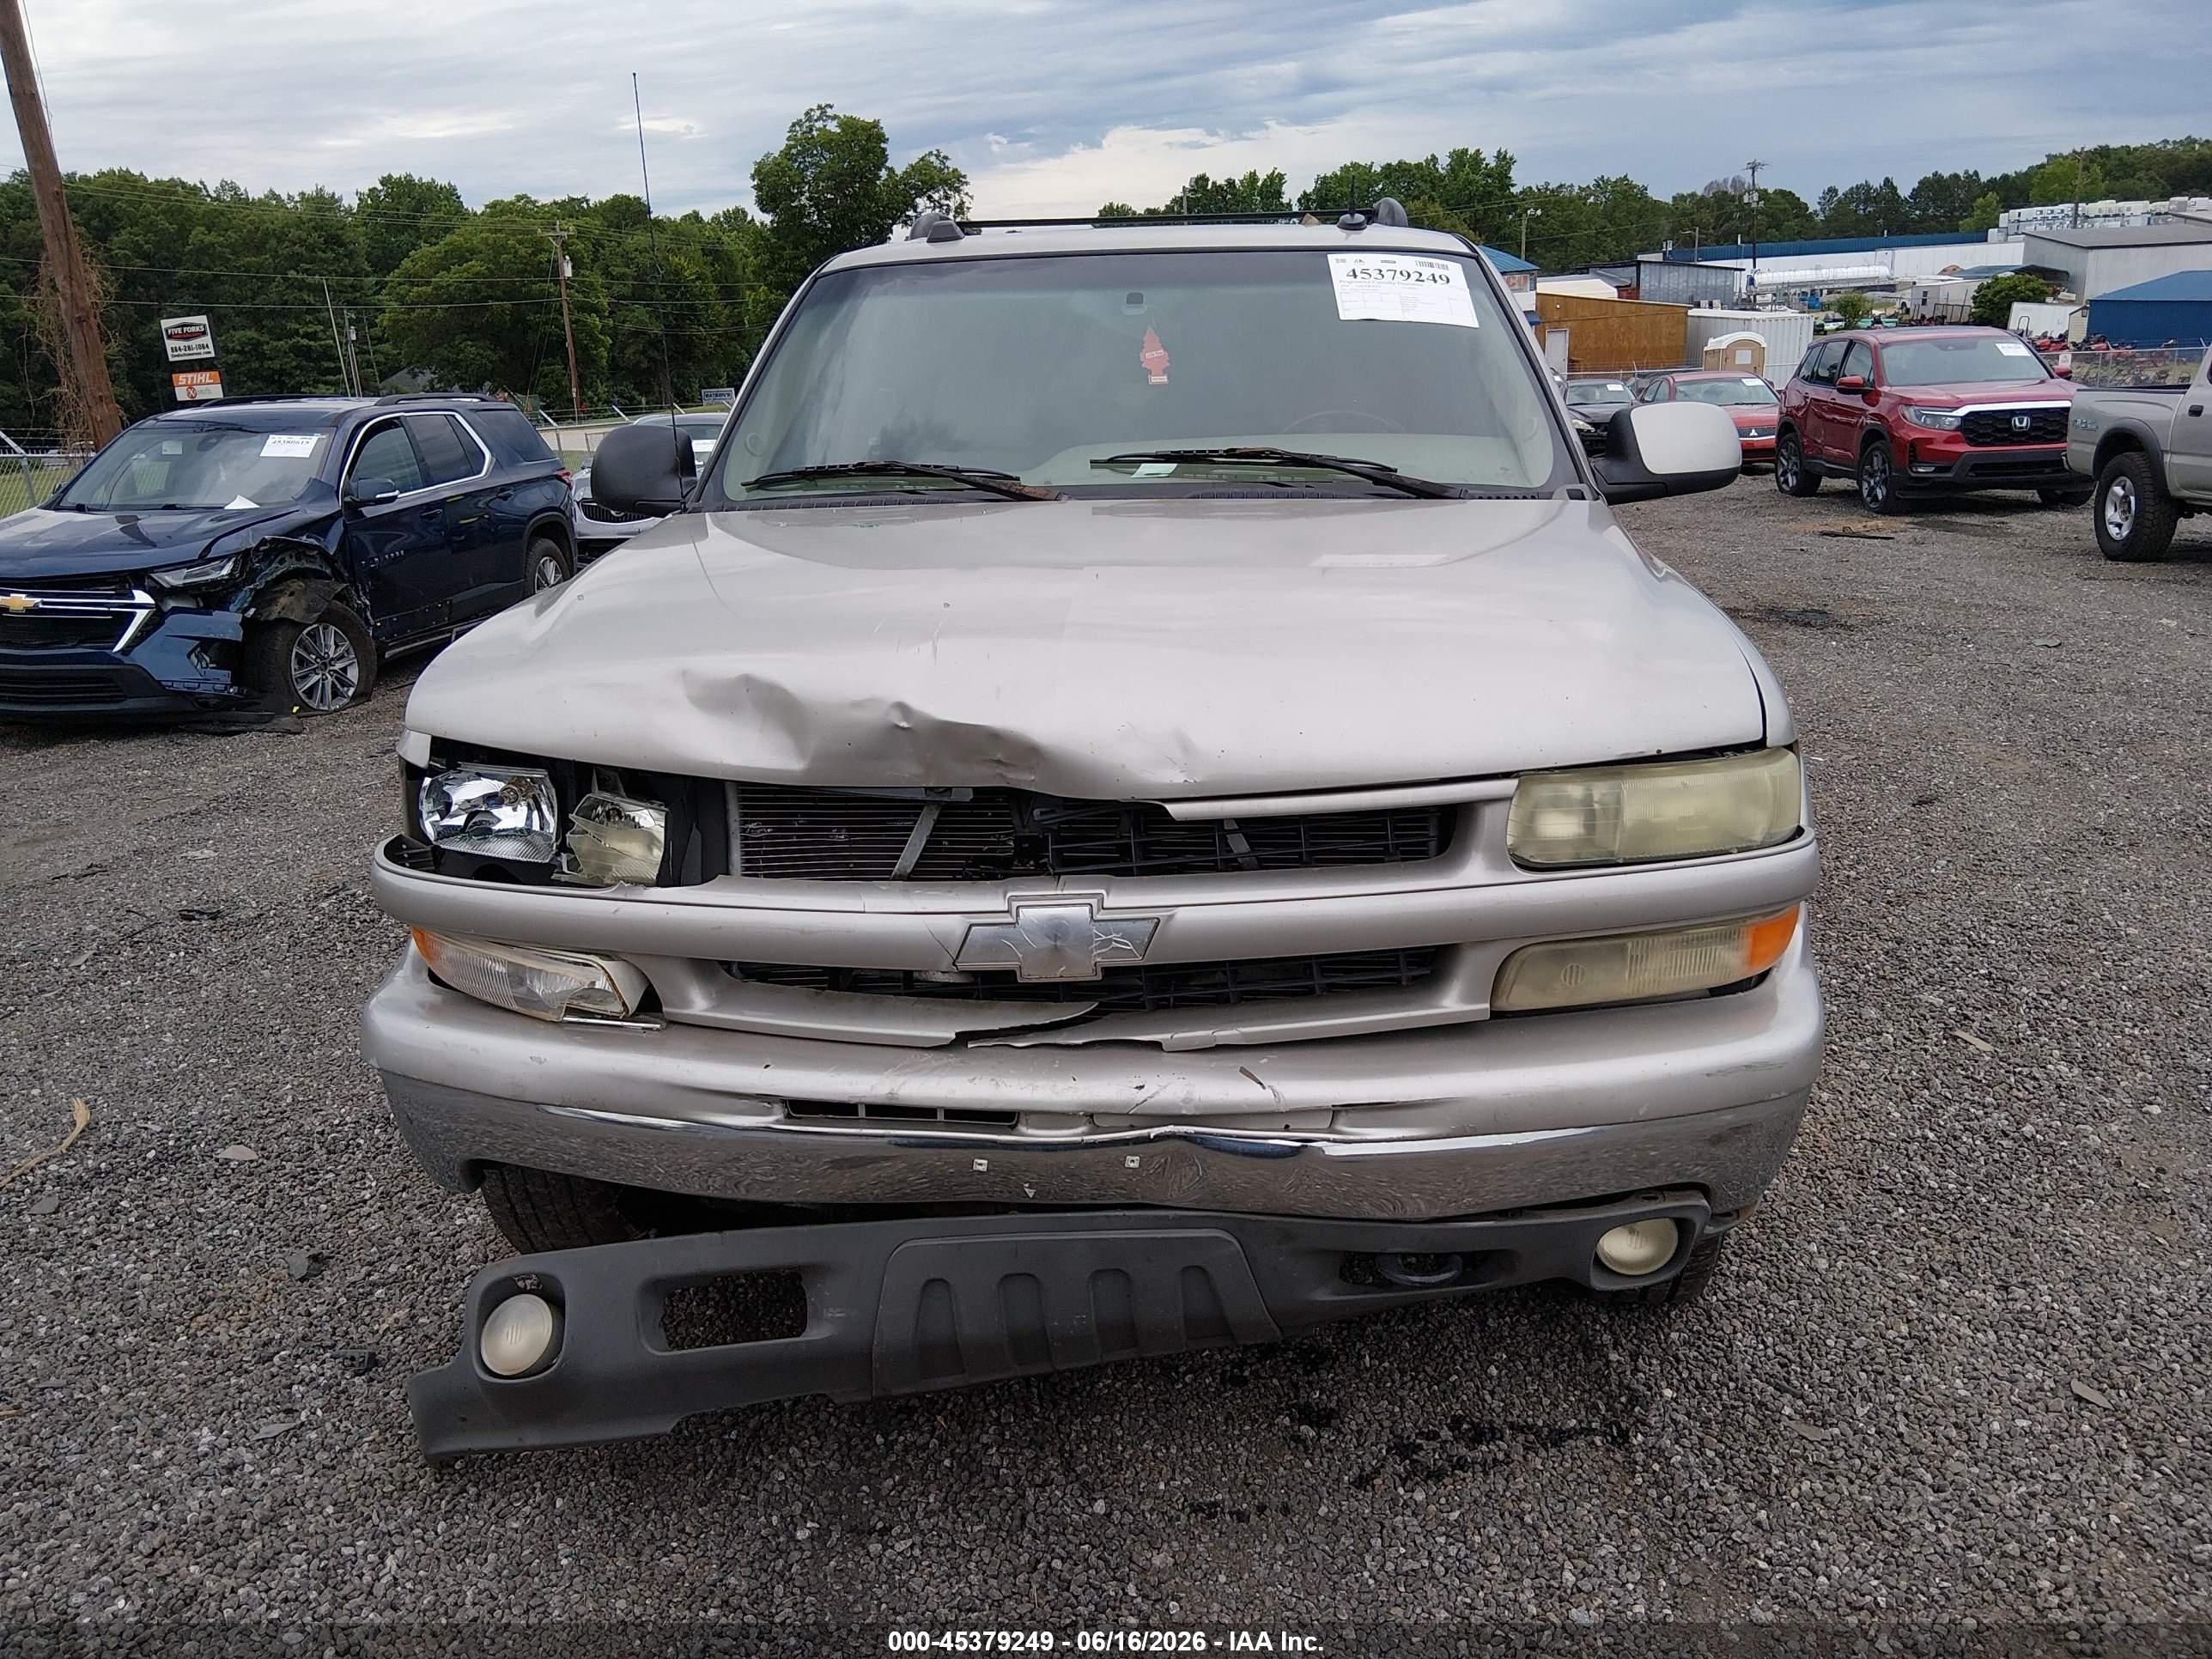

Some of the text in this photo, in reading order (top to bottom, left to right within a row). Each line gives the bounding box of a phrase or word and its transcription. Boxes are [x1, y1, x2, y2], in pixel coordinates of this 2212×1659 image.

[1346, 268, 1450, 285] 45379249
[167, 327, 183, 336] FIVE
[183, 325, 205, 334] FORKS
[179, 373, 214, 386] STIHL
